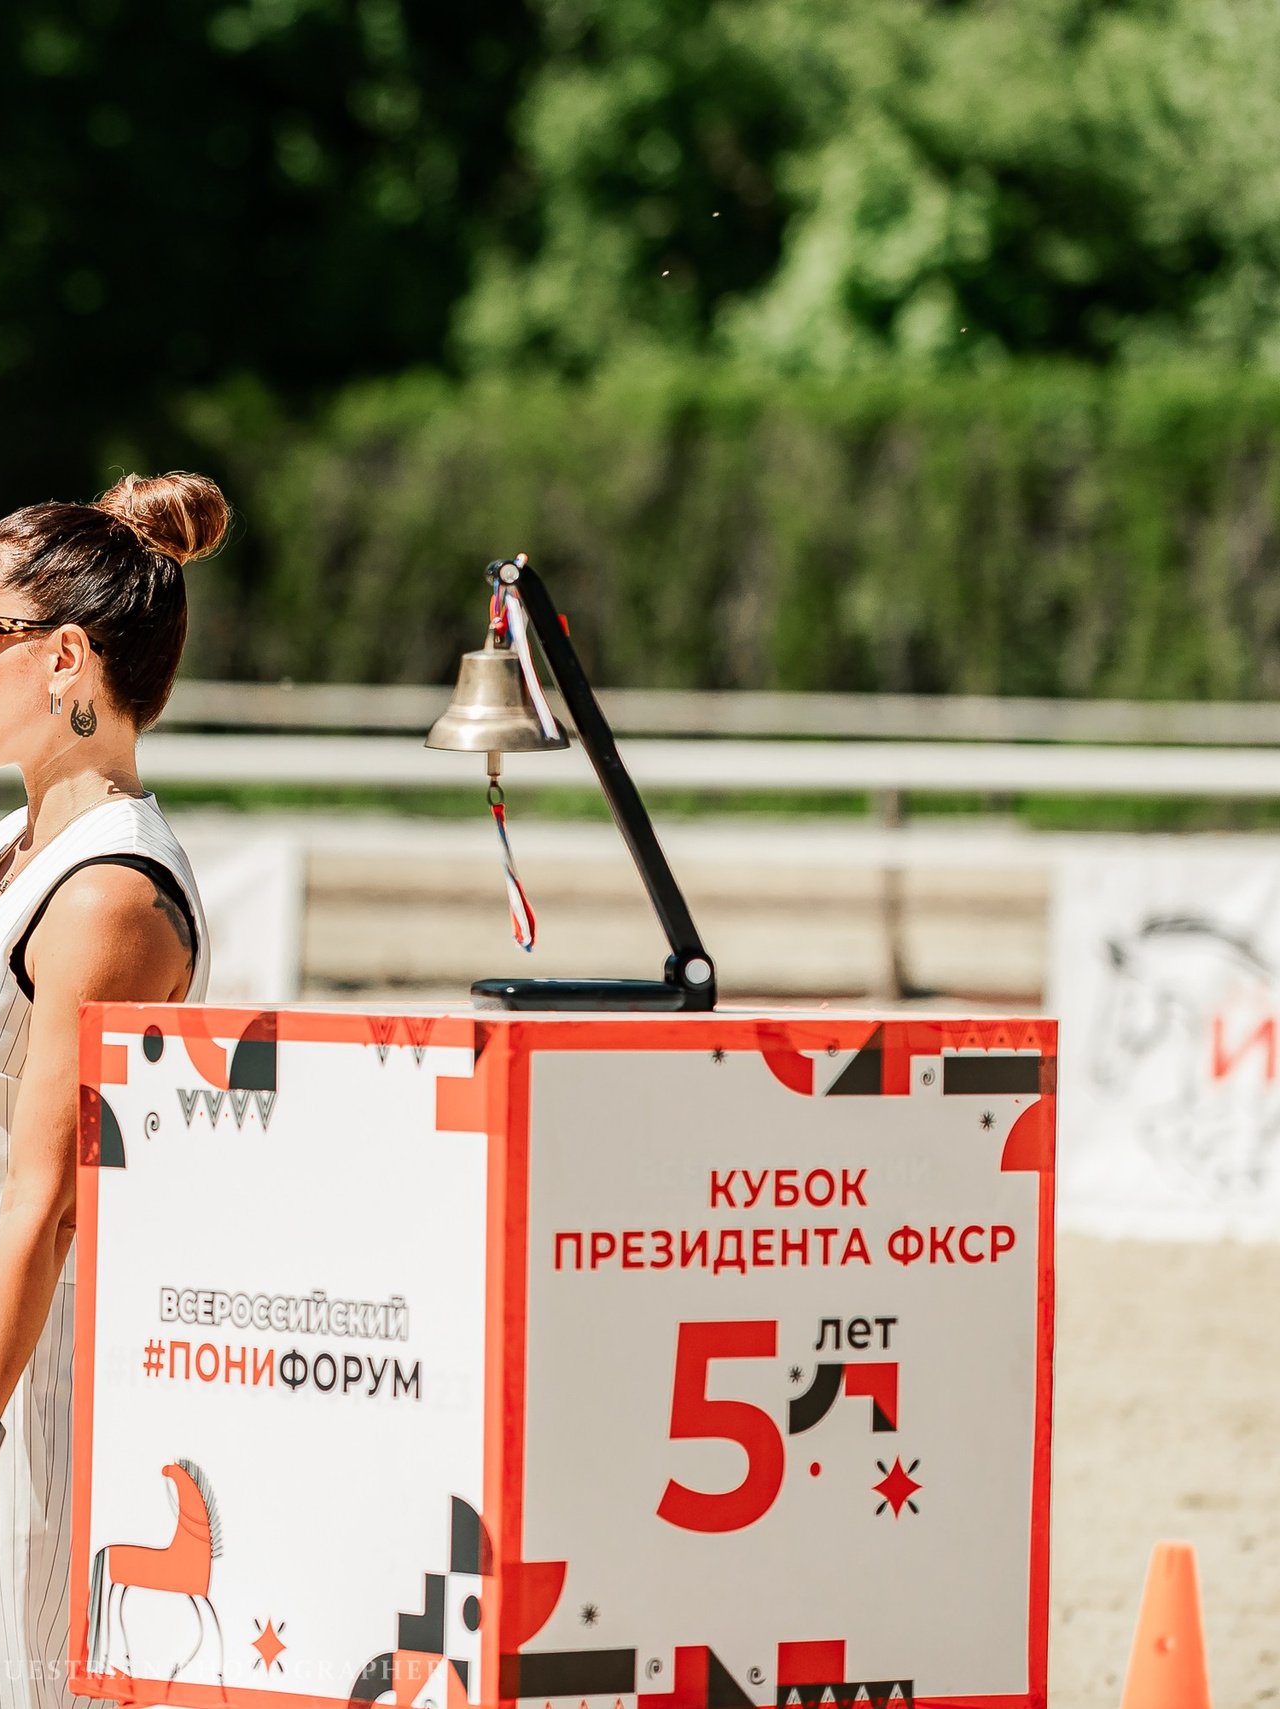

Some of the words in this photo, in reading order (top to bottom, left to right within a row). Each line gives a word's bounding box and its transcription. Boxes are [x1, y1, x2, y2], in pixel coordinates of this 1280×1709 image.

[709, 1167, 869, 1210] КУБОК
[553, 1226, 873, 1277] ПРЕЗИДЕНТА
[886, 1224, 1018, 1268] ФКСР
[159, 1286, 410, 1341] ВСЕРОССИЙСКИЙ
[142, 1338, 421, 1400] #ПОНИФОРУМ
[655, 1318, 787, 1535] 5
[815, 1316, 899, 1351] лет
